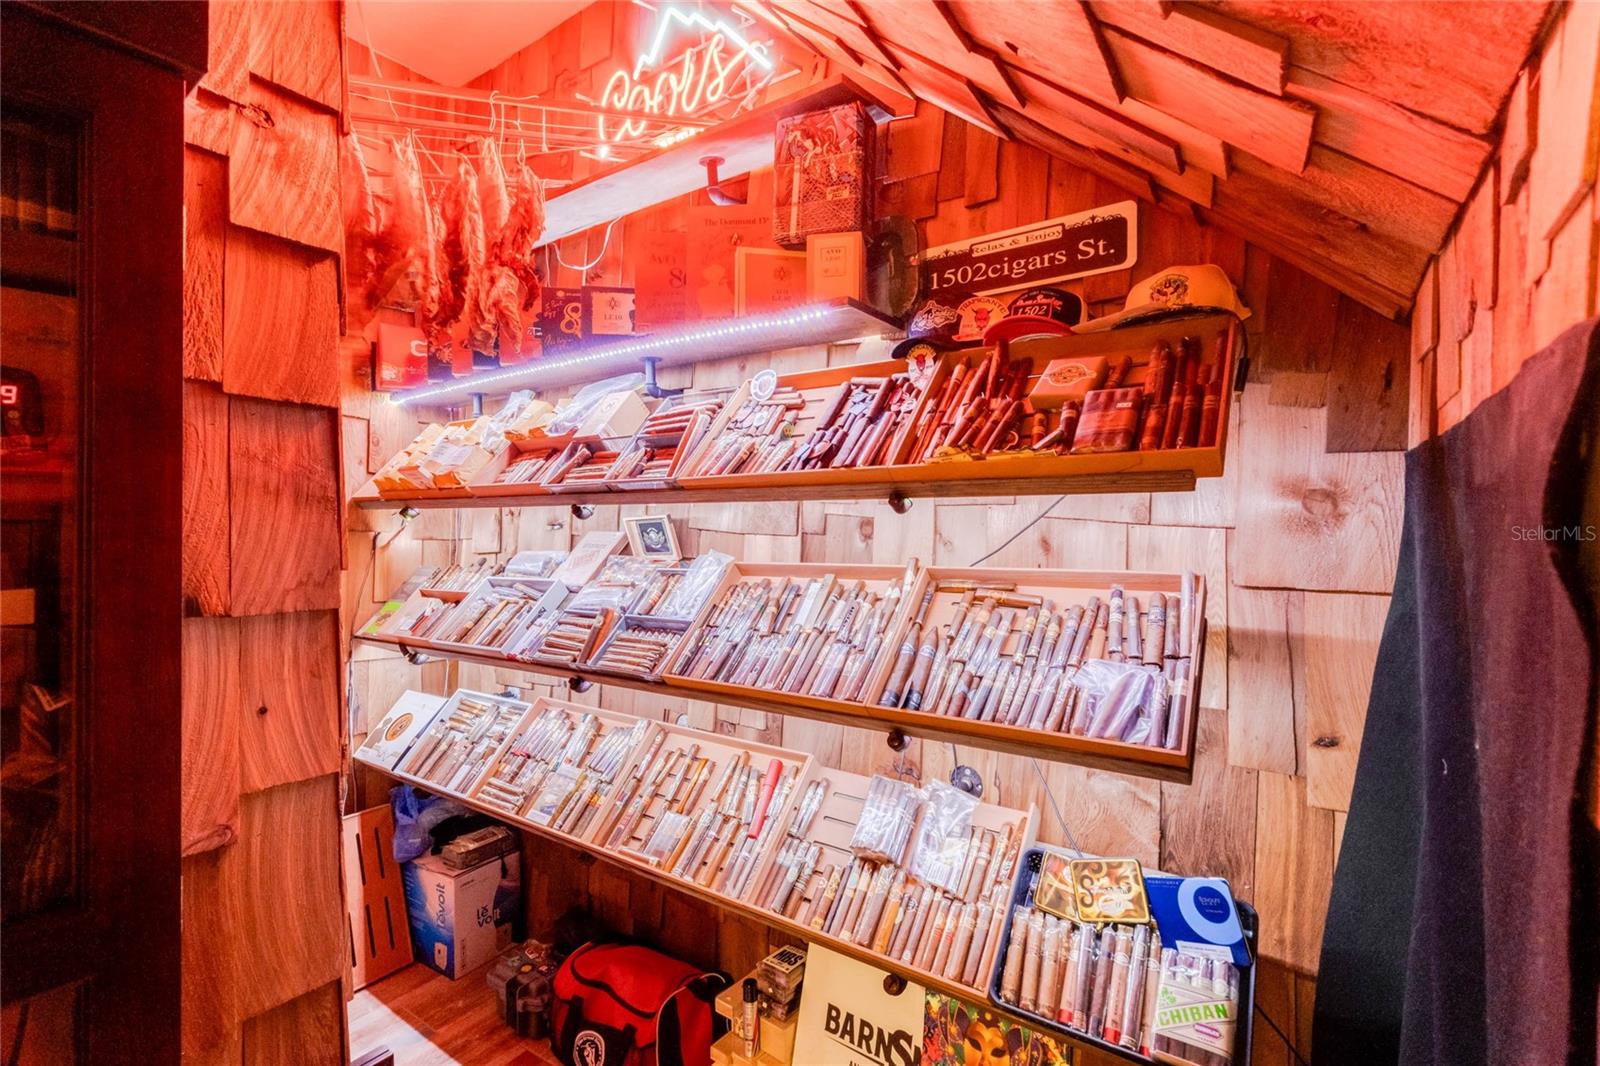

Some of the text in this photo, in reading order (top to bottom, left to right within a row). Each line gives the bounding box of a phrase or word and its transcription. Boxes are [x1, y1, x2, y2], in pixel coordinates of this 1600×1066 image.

[972, 229, 1062, 256] Relax & Enjoy
[930, 238, 1116, 291] 1502cigars St.
[1018, 305, 1048, 317] 1502
[0, 384, 18, 404] 9
